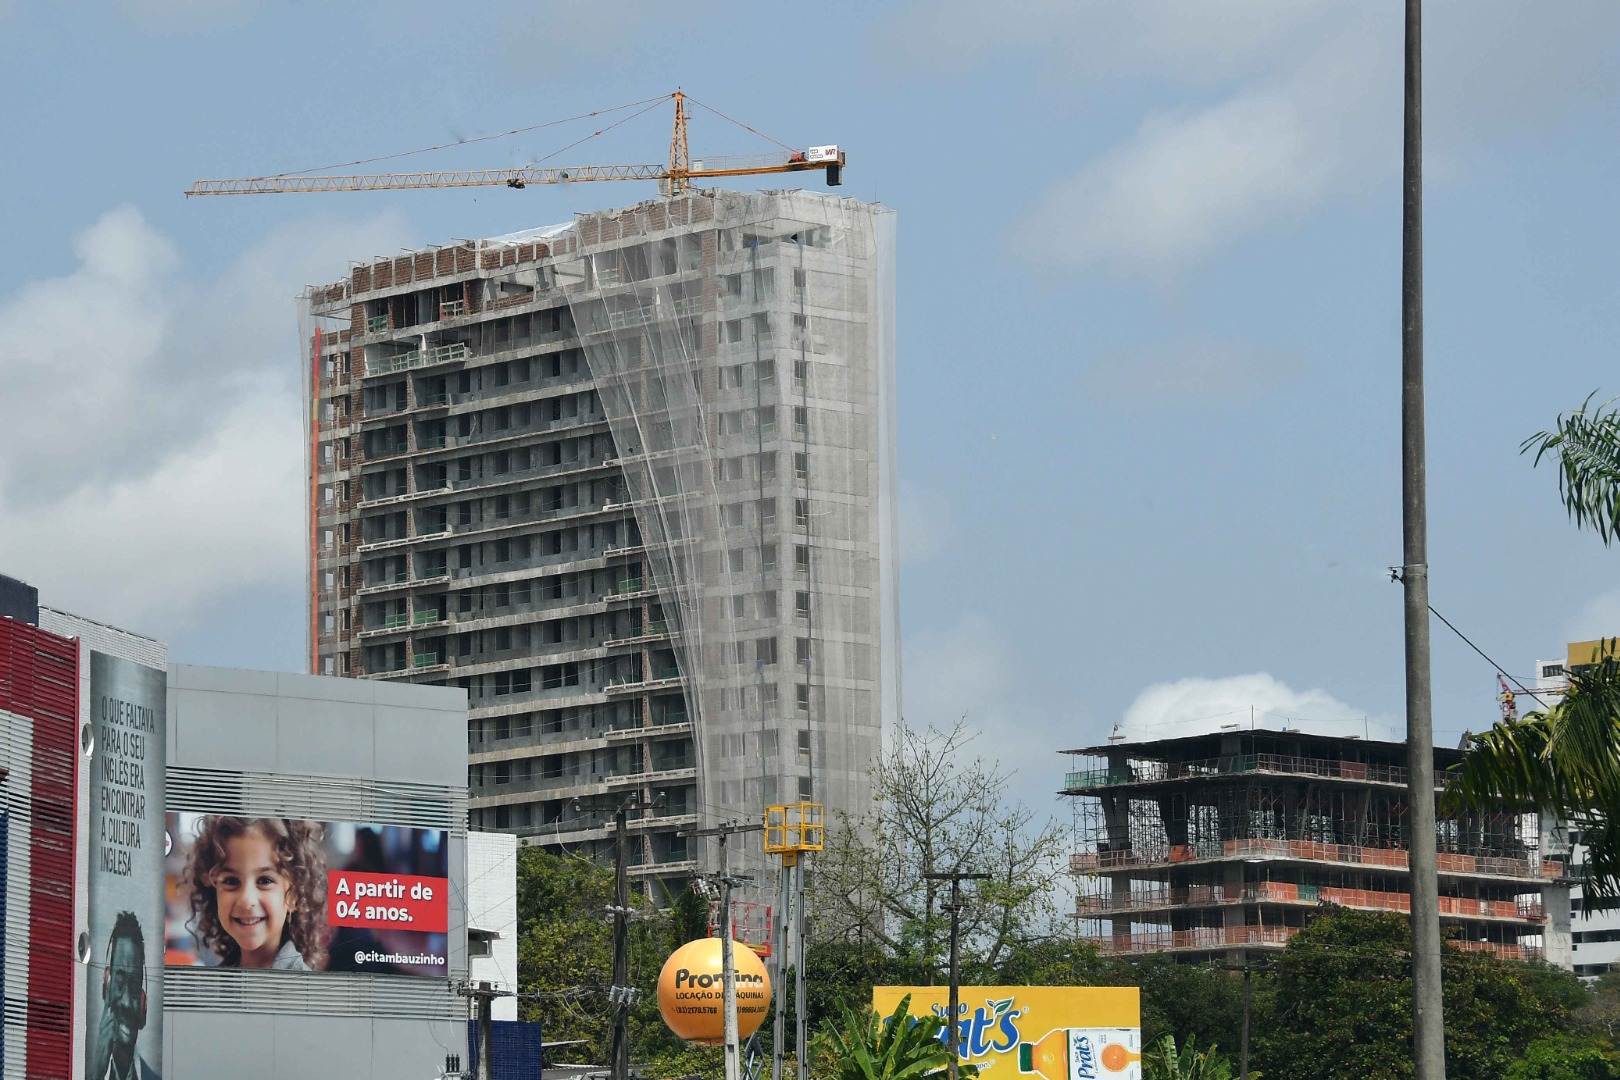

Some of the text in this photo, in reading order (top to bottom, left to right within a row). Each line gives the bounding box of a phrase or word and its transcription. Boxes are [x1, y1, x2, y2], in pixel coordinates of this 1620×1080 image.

[102, 696, 154, 734] O QUE FALTAVA
[102, 725, 144, 760] PARA O SEU
[101, 754, 145, 789] INGLÊS ERA
[101, 786, 145, 820] ENCONTRAR
[101, 816, 140, 849] A CULTURA
[101, 846, 132, 877] INGLESA
[336, 878, 433, 900] A partir de
[336, 901, 413, 922] 04 anos.
[354, 951, 445, 965] @citambauzinho
[676, 990, 713, 1001] LOCAÇÃO
[735, 990, 764, 1000] ÁQUINAS
